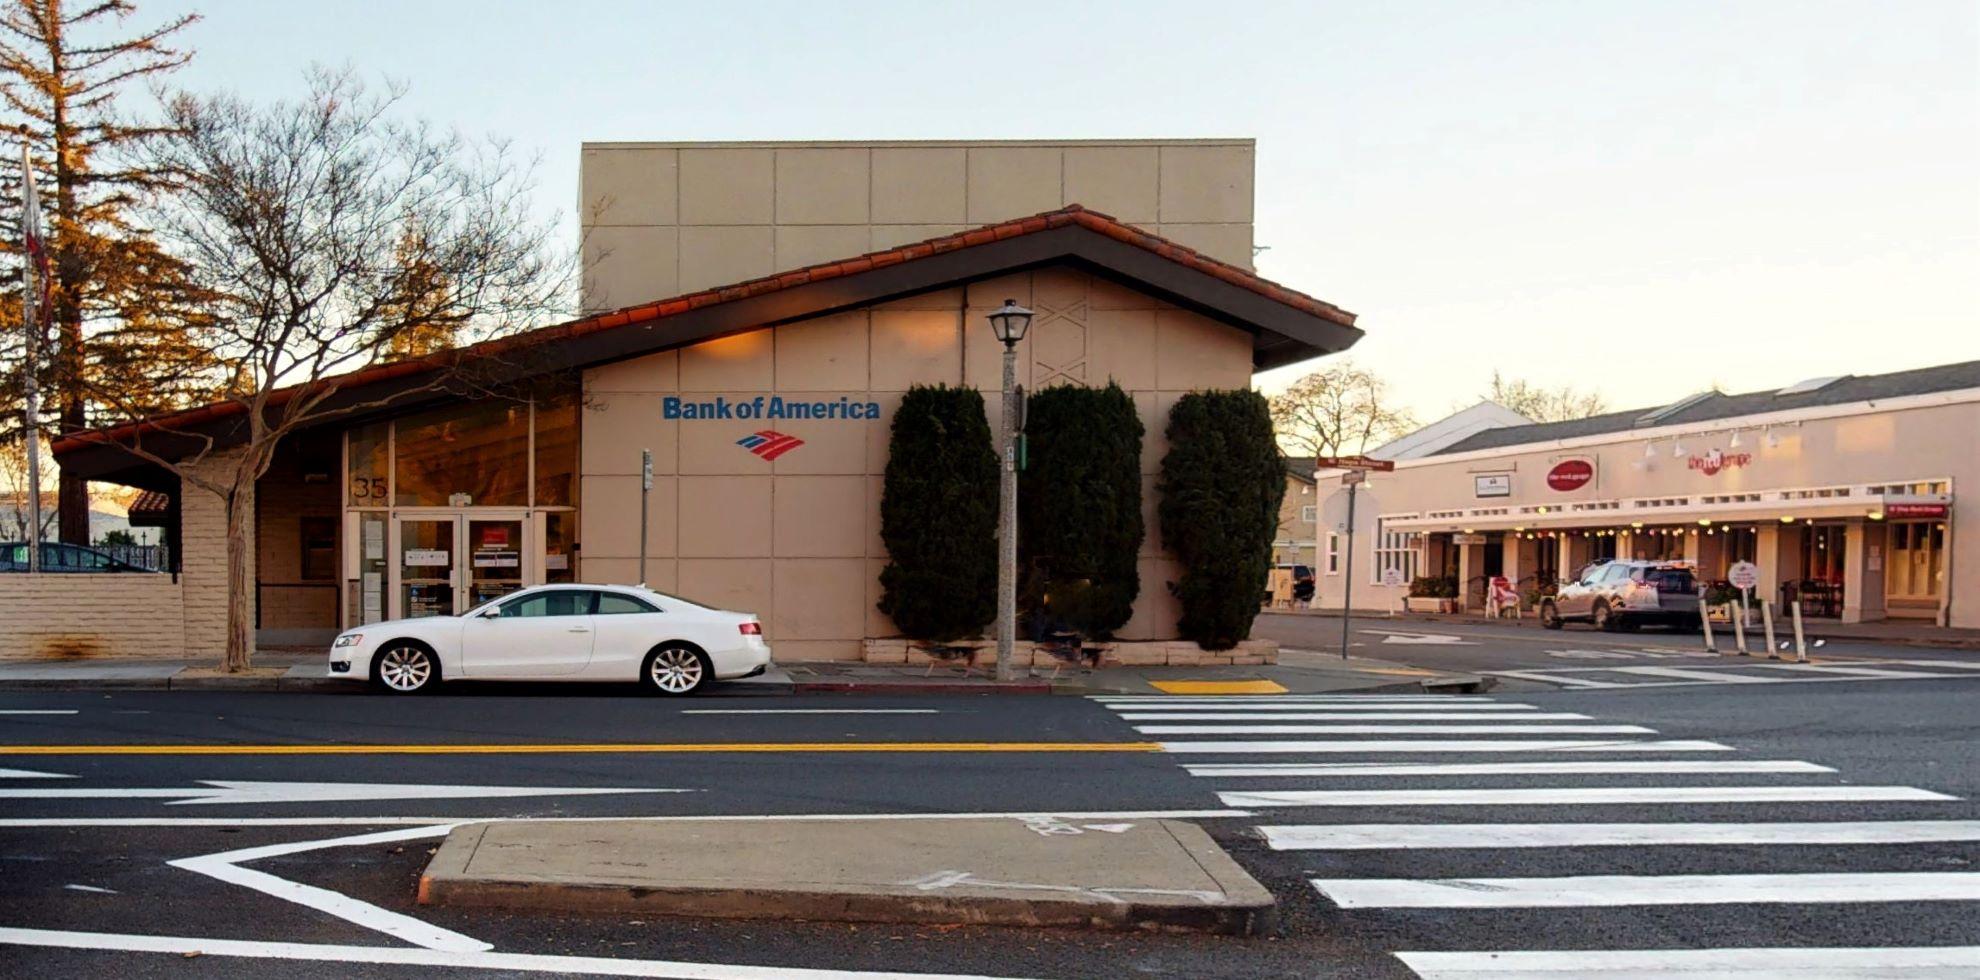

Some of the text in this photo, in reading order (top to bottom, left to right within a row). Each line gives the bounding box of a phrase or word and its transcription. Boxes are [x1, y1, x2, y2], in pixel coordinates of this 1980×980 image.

[662, 396, 881, 420] Bank of America
[353, 478, 387, 499] 35
